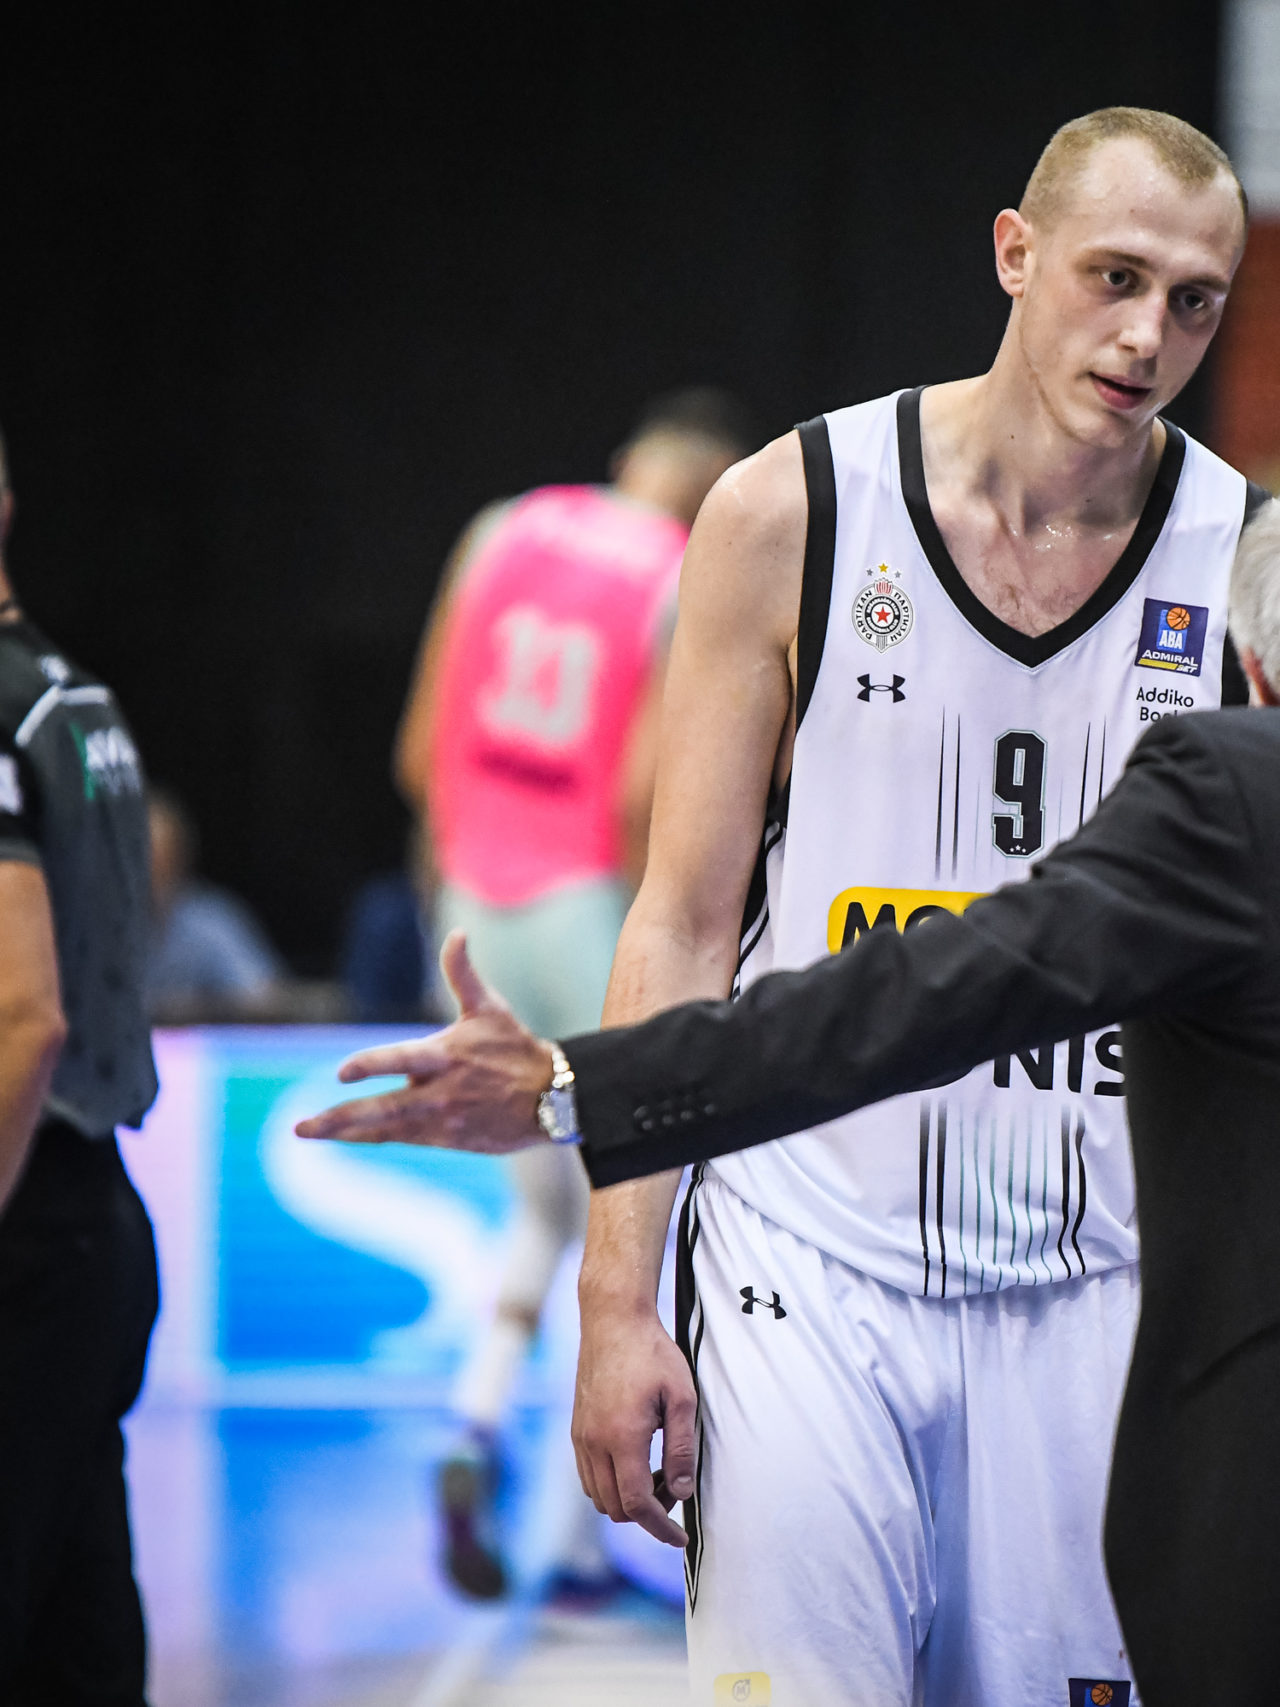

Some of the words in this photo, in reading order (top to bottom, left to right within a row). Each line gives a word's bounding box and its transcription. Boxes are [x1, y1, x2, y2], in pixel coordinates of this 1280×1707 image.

[855, 589, 873, 640] PARTIZAN
[1158, 629, 1184, 650] ABA
[1141, 649, 1199, 668] ADMIRAL
[1136, 686, 1195, 708] Addiko
[992, 729, 1048, 858] 9
[993, 1030, 1125, 1097] NIS
